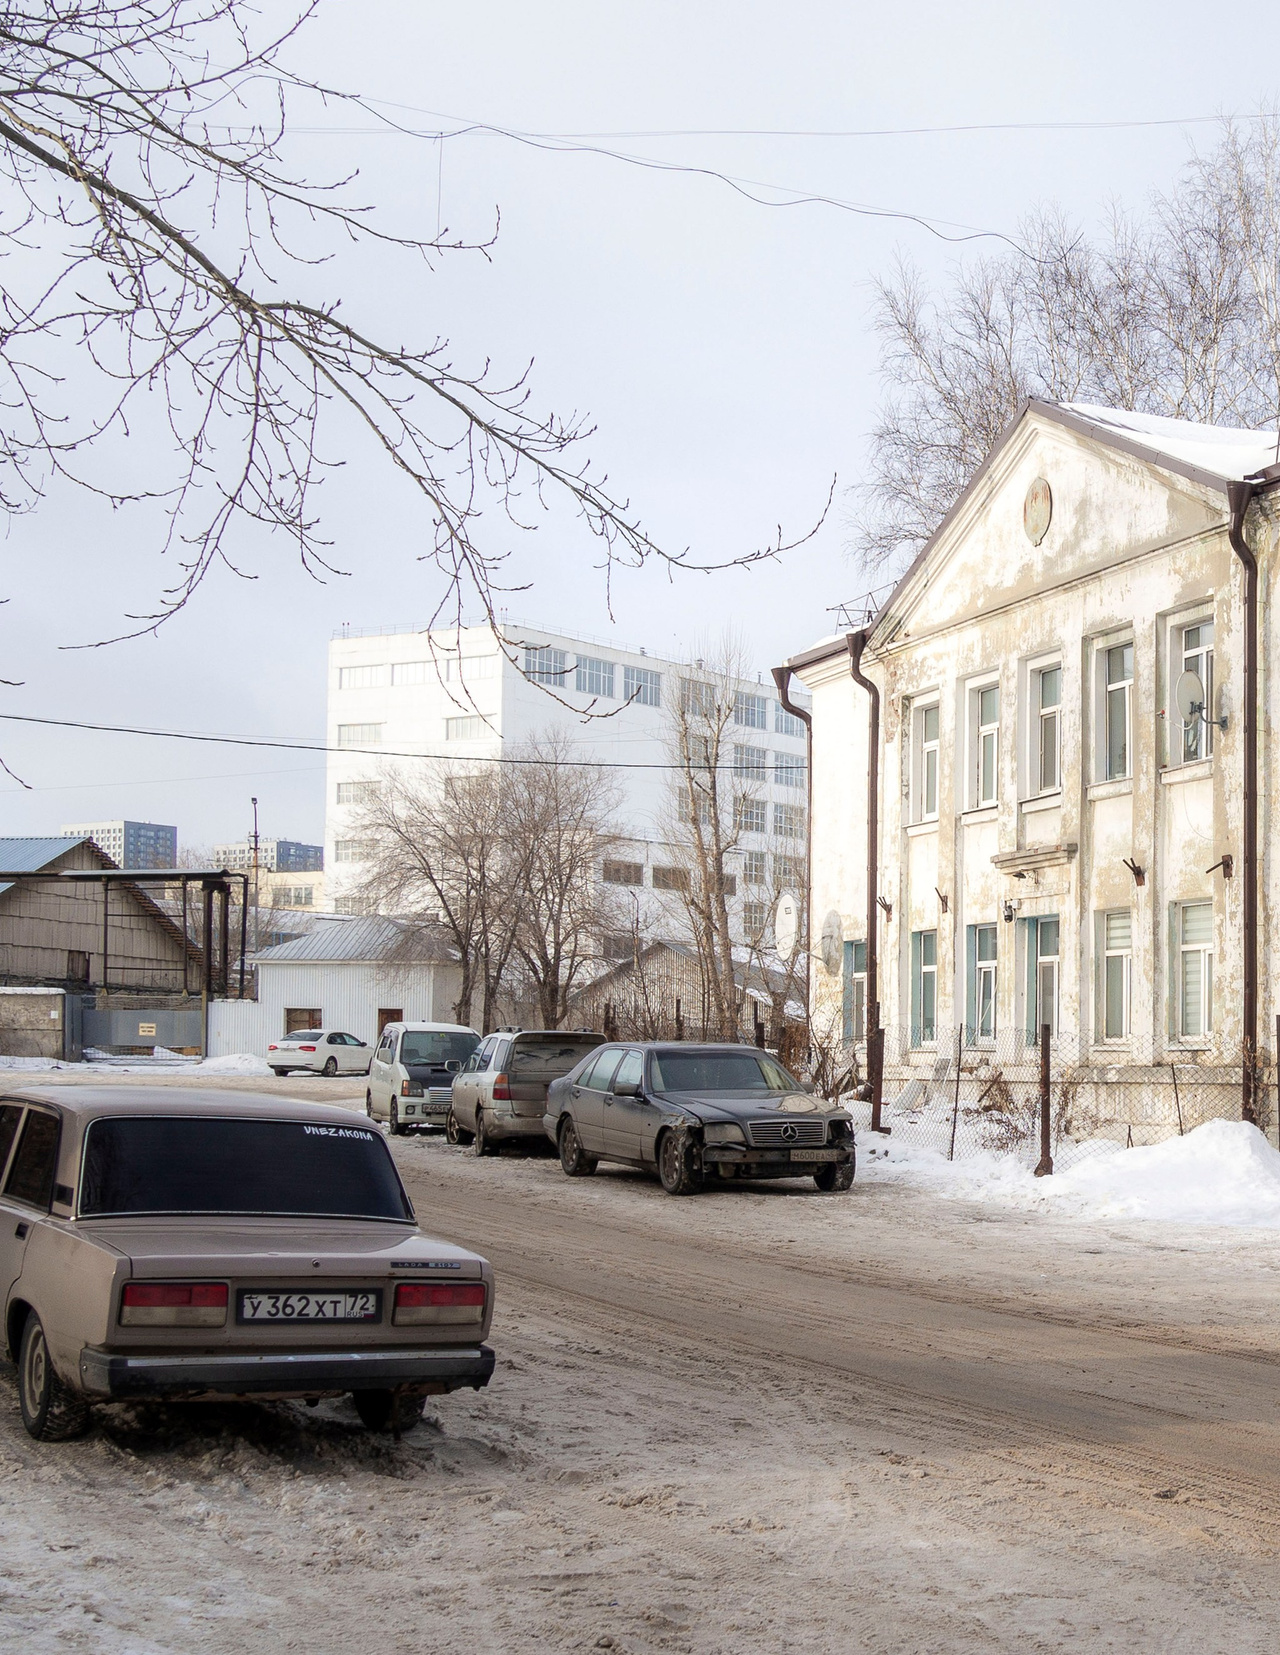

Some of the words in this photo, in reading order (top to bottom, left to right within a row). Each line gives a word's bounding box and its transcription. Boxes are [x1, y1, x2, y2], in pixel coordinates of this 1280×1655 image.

[303, 1125, 374, 1142] VNEZAKONA
[347, 1294, 370, 1312] 72
[346, 1310, 364, 1318] RUS
